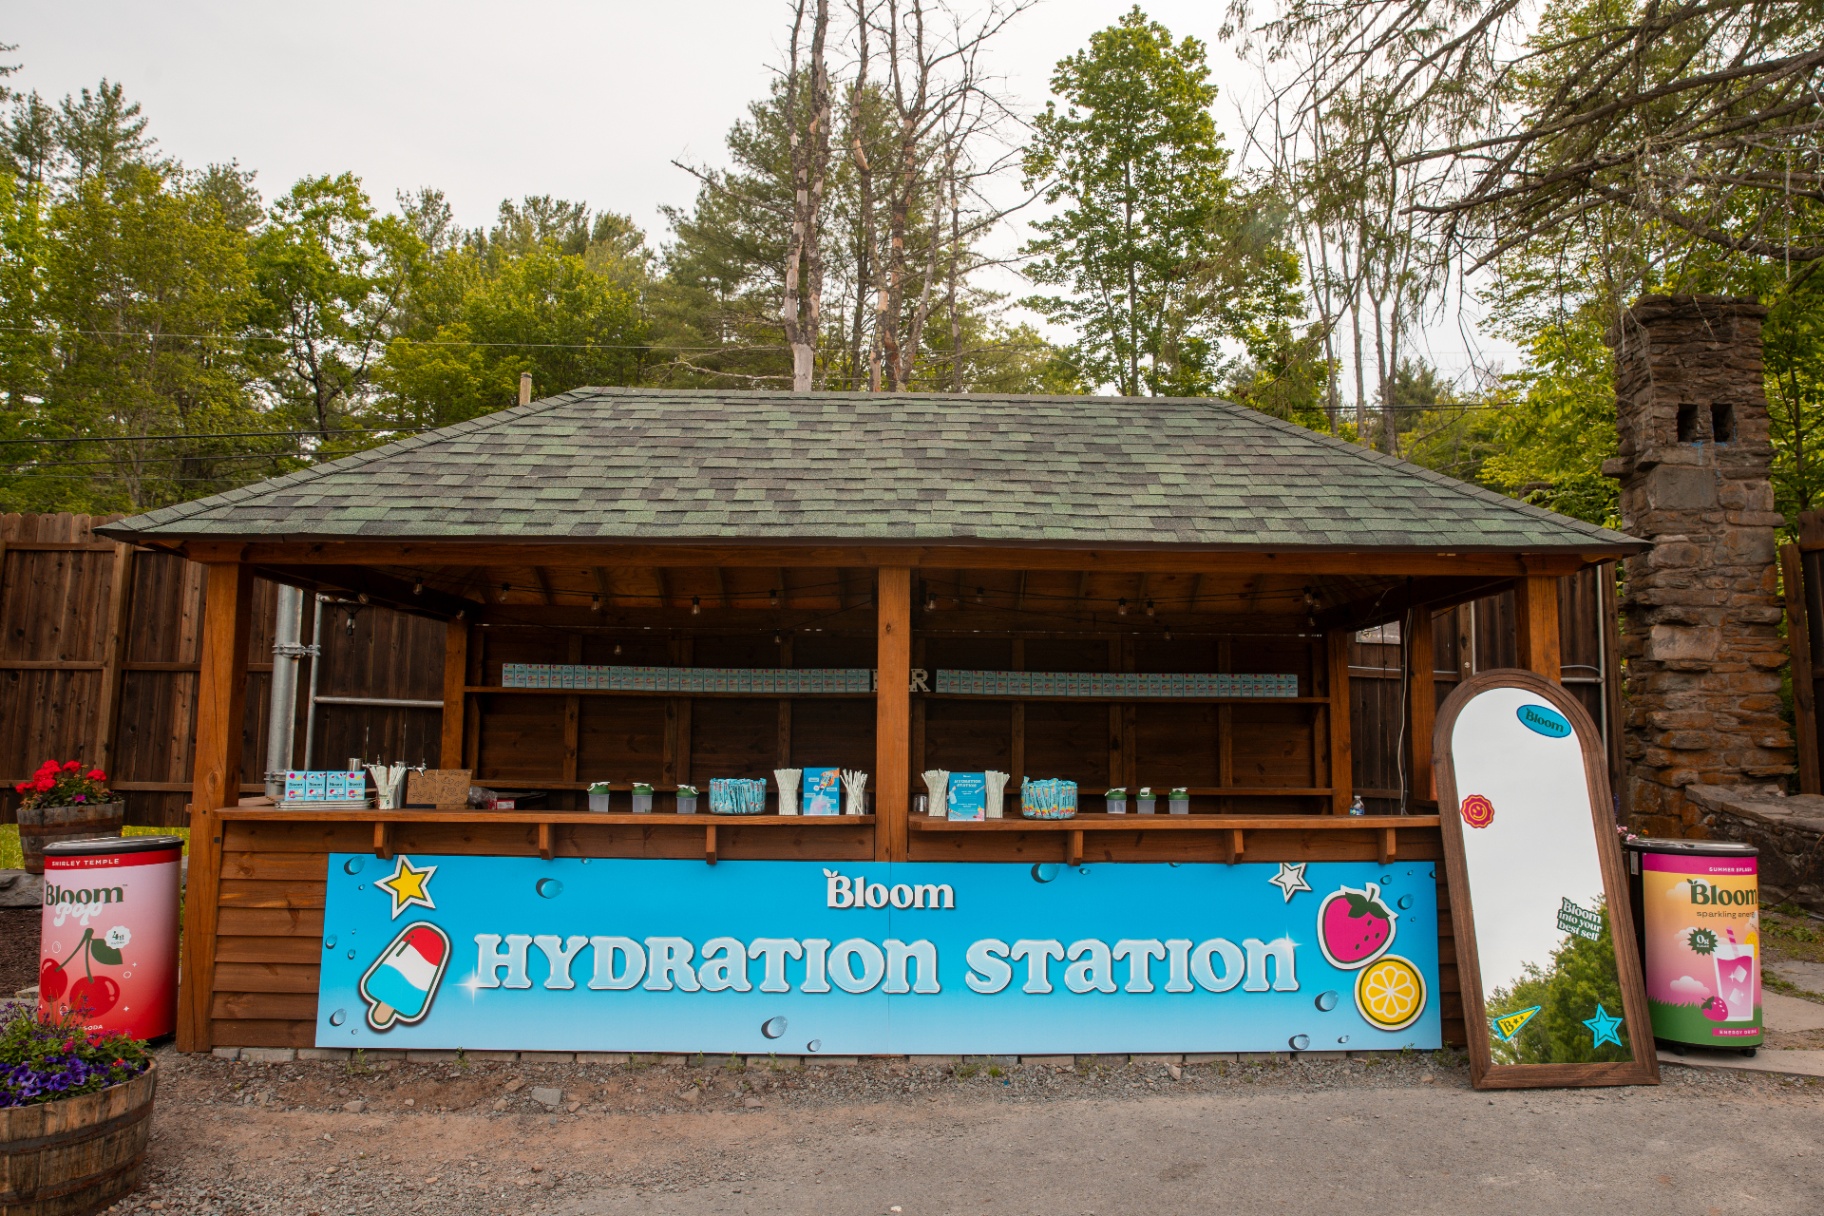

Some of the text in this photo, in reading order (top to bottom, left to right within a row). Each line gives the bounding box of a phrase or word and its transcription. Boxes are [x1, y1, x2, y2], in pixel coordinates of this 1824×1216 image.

[1525, 709, 1564, 733] Bloom
[84, 858, 120, 866] TEMPLE
[45, 883, 124, 906] Bloom
[826, 873, 955, 909] Bloom
[1690, 883, 1758, 906] Bloom
[1558, 909, 1602, 932] into your
[1562, 898, 1602, 924] Bloom
[1696, 910, 1737, 920] sparkling
[1558, 920, 1599, 941] best self
